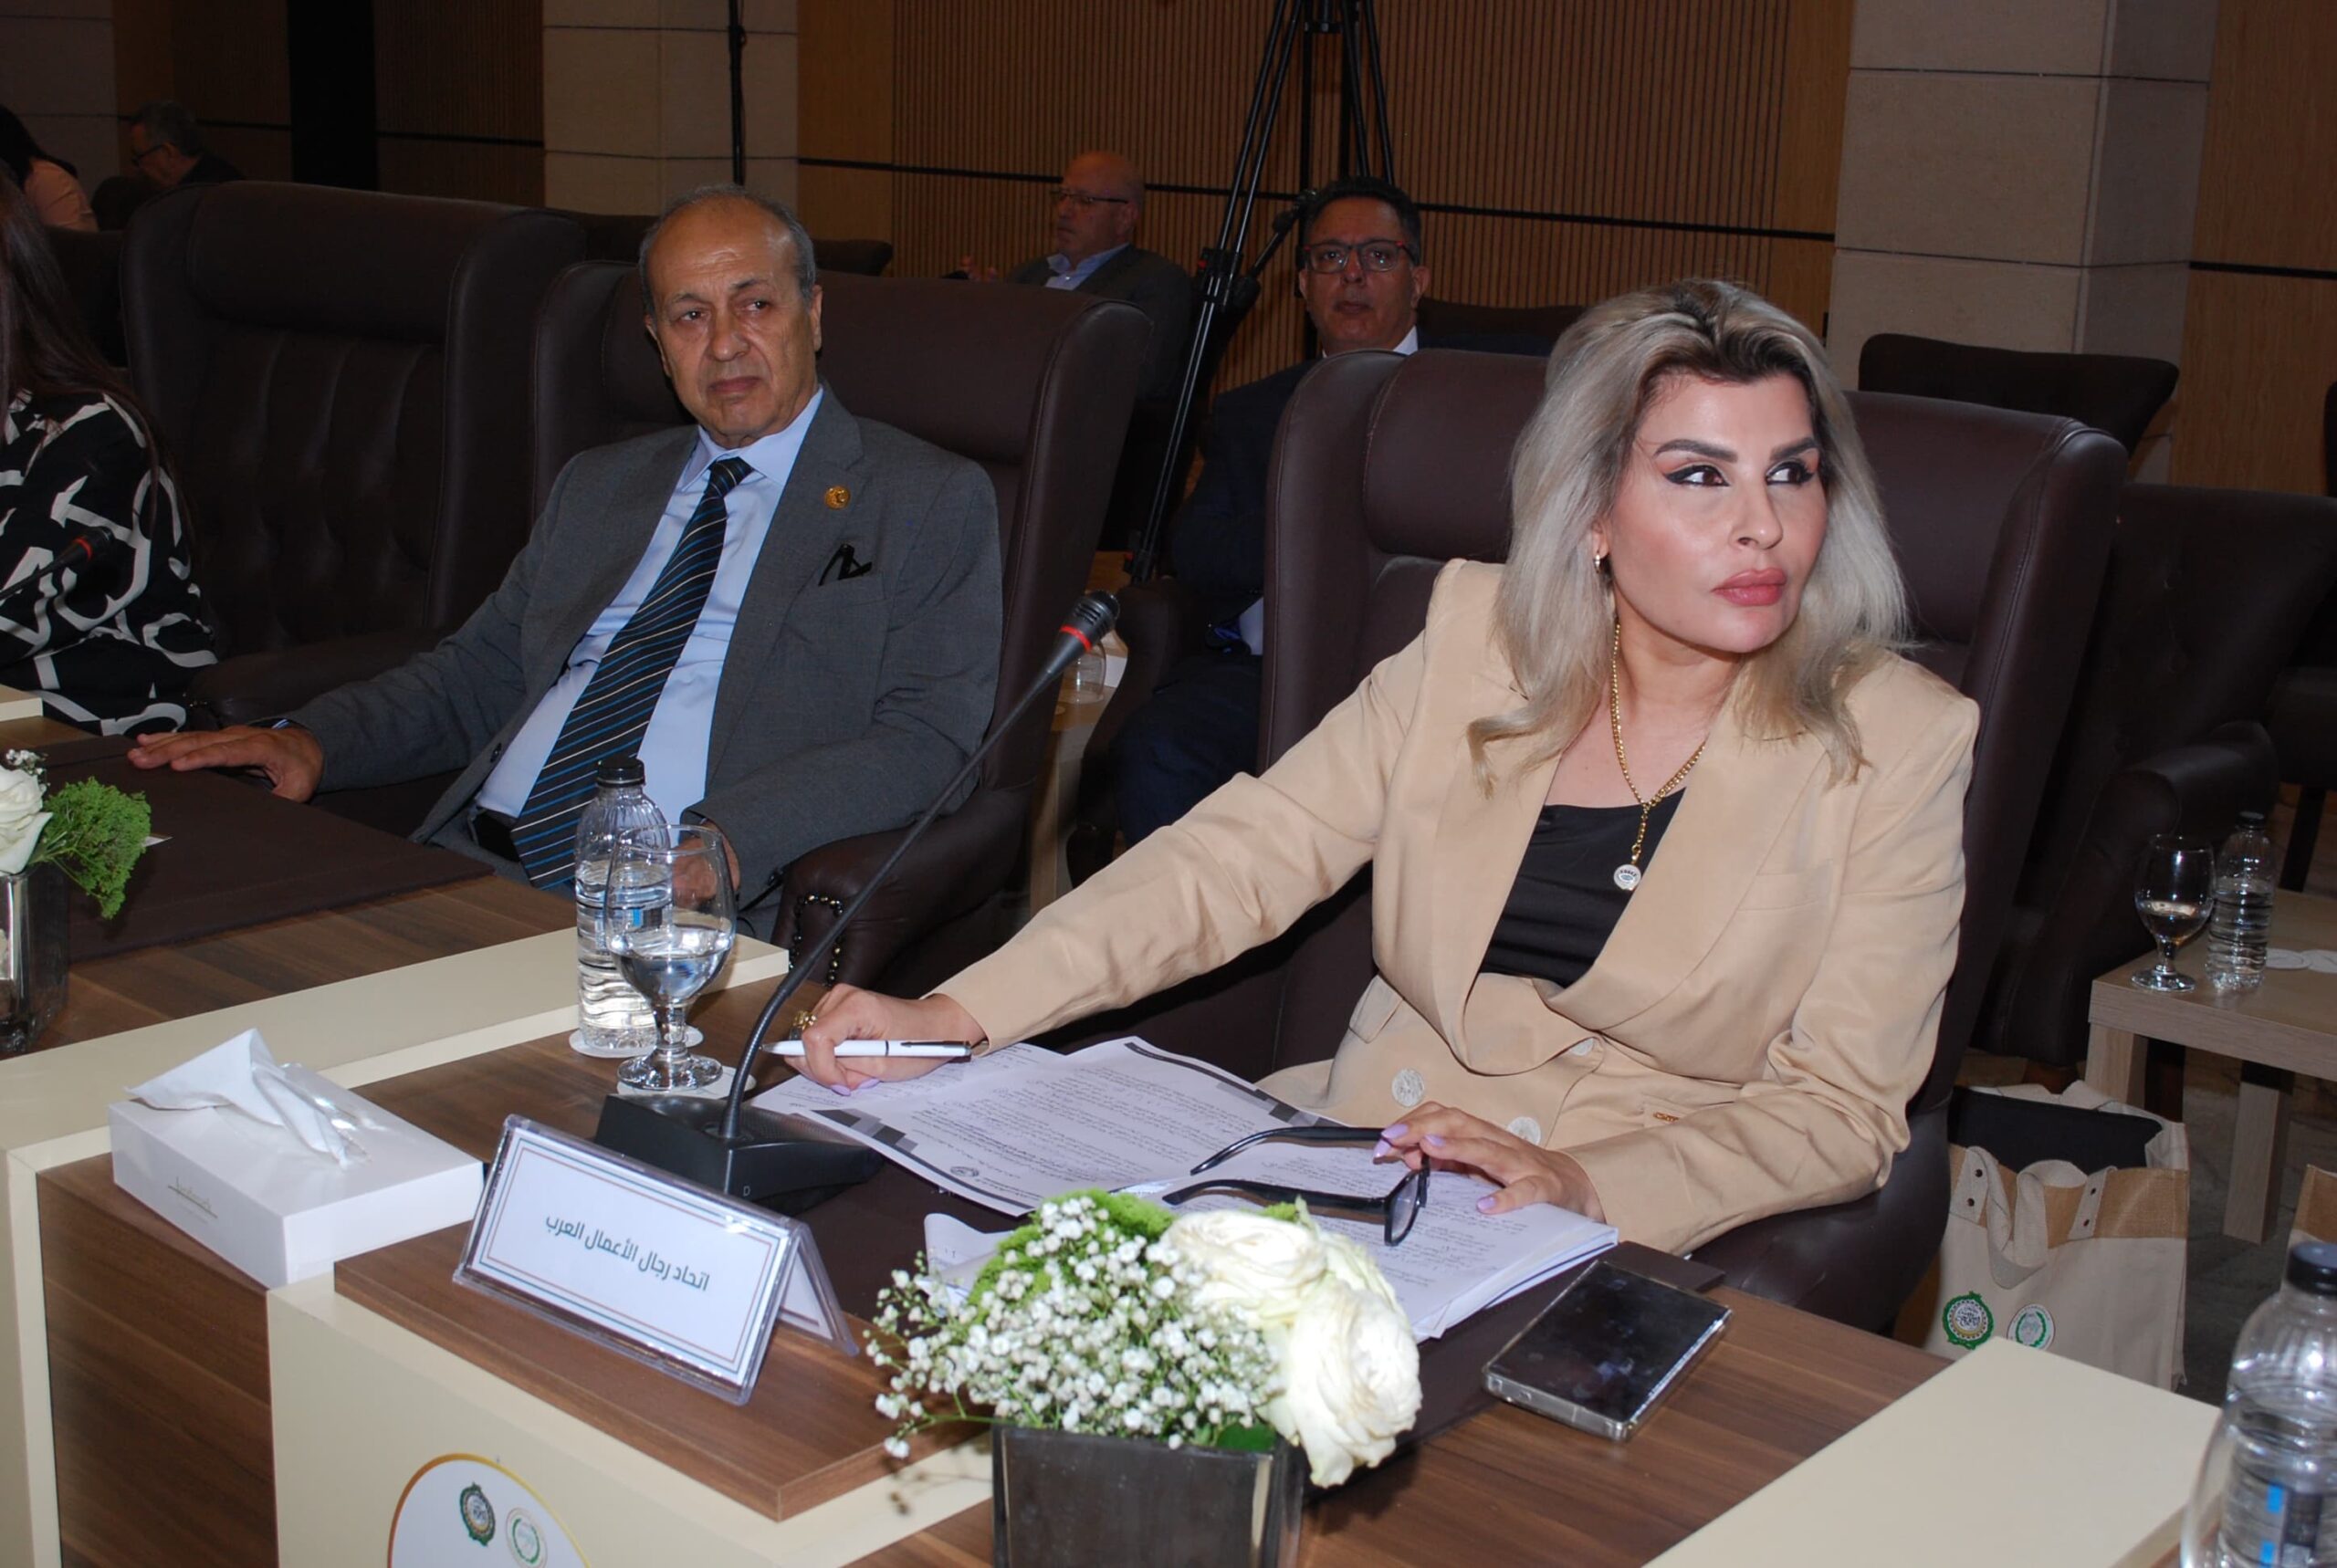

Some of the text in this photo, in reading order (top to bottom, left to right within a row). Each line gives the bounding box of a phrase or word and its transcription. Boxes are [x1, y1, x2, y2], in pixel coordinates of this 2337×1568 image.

[545, 1216, 710, 1291] اتحاد رجال الأعمال العرب
